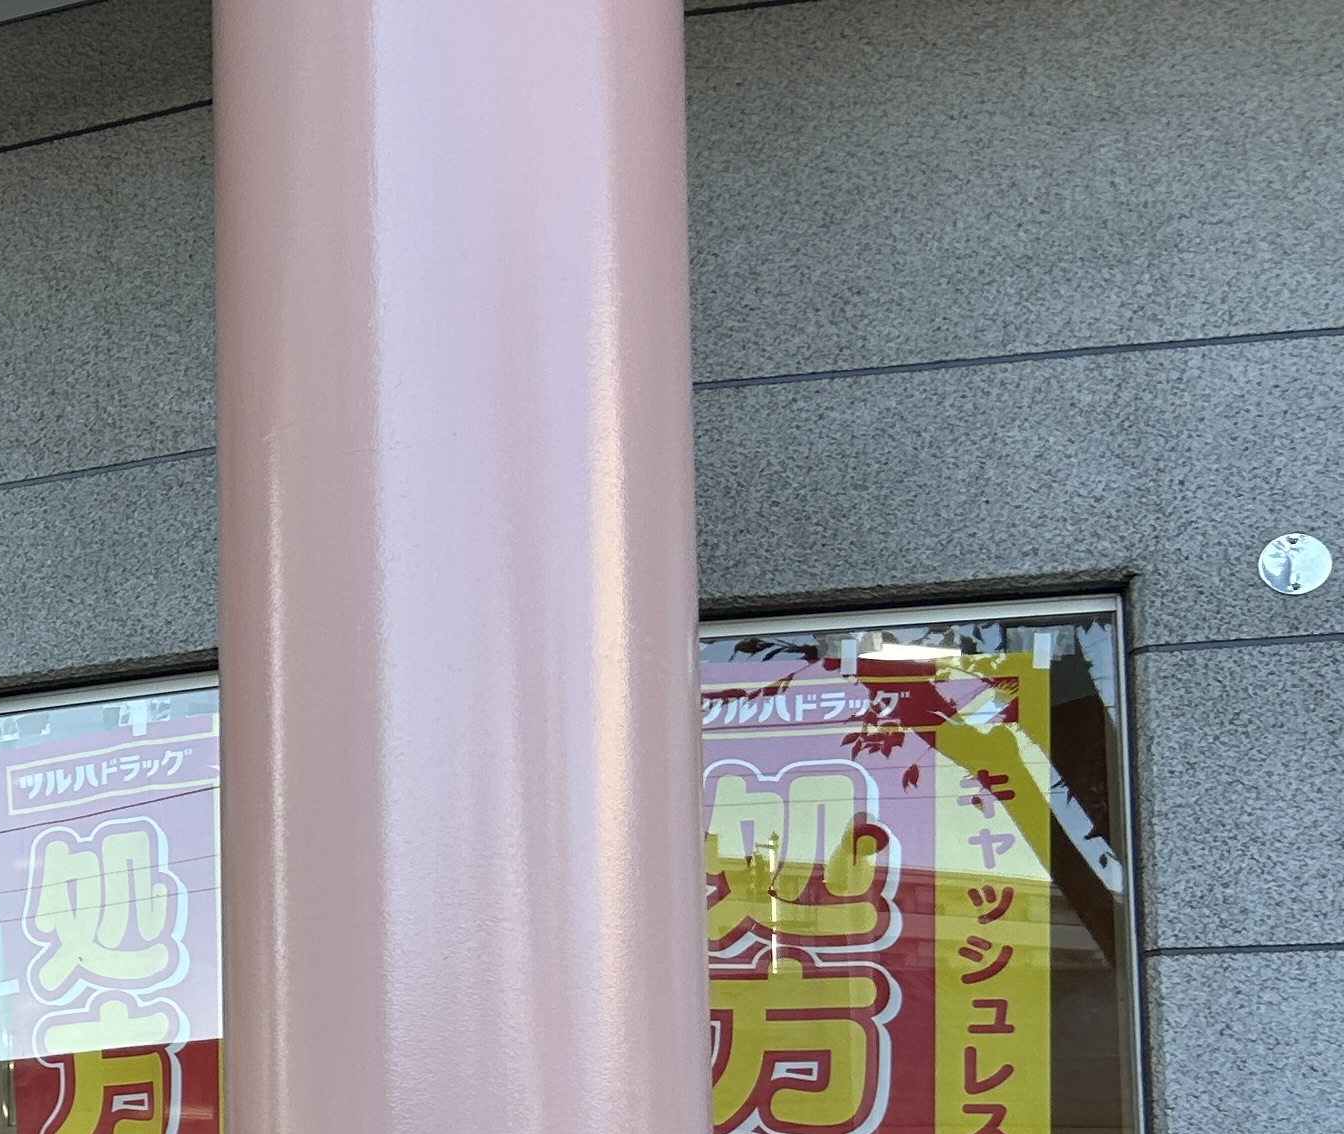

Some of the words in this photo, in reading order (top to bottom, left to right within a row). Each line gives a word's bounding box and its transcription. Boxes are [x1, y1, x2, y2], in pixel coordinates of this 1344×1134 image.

[18, 747, 196, 801] ツルハドラッグ
